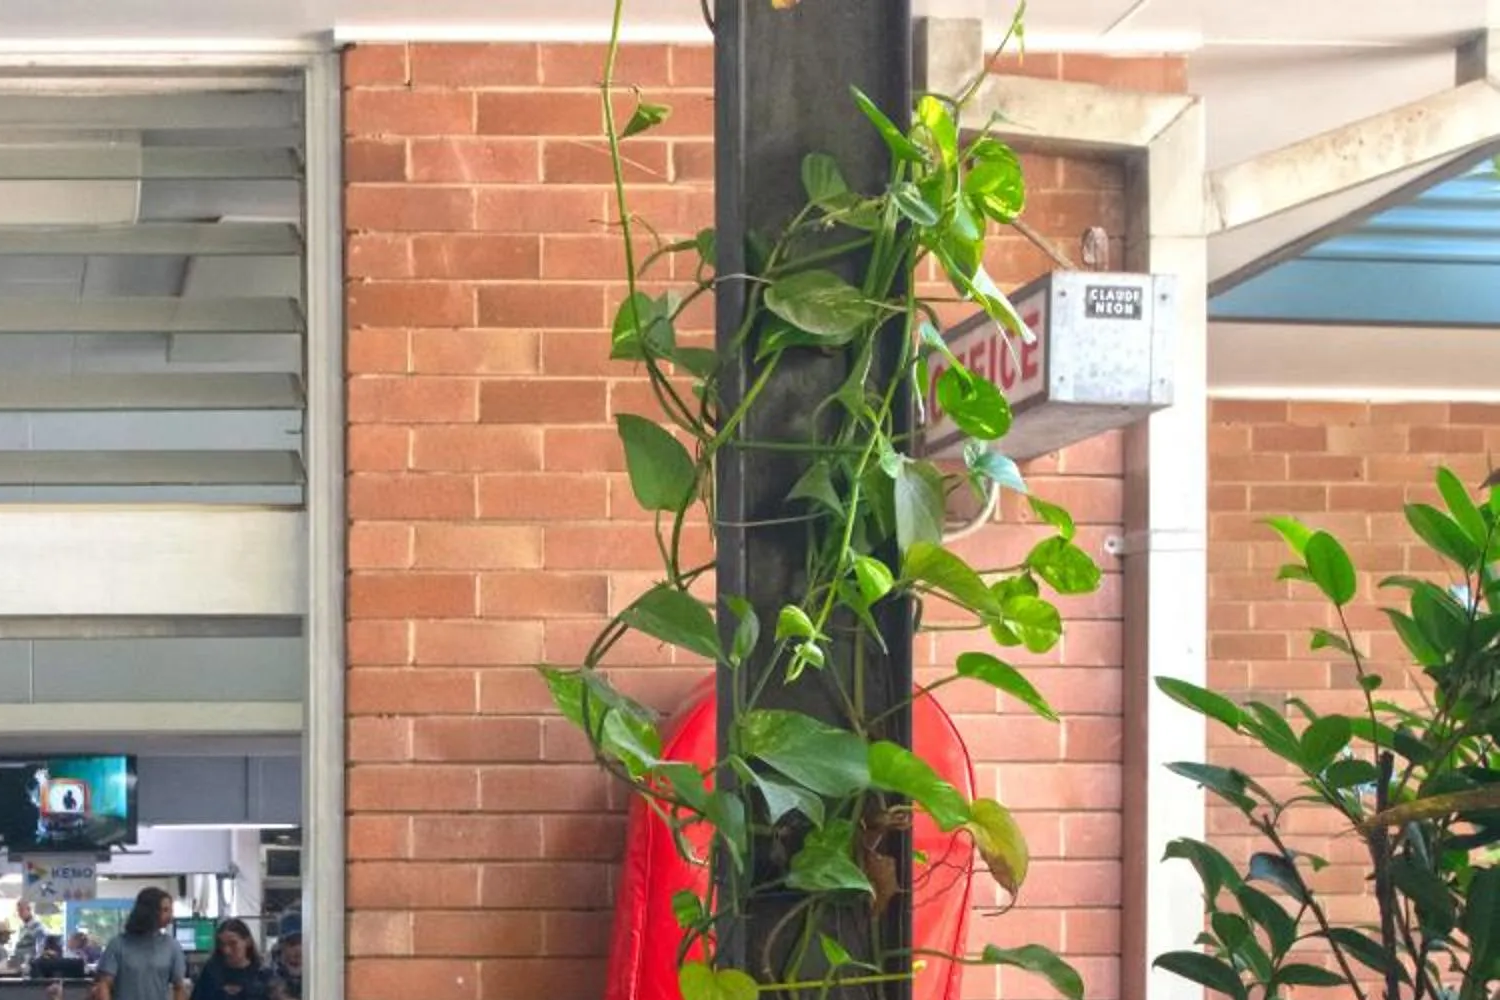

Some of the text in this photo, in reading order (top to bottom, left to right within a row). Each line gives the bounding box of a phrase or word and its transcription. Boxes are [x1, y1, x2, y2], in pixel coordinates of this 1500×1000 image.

[1090, 288, 1140, 302] CLAUDE
[1095, 301, 1134, 315] NEON
[929, 308, 1040, 425] OFICE
